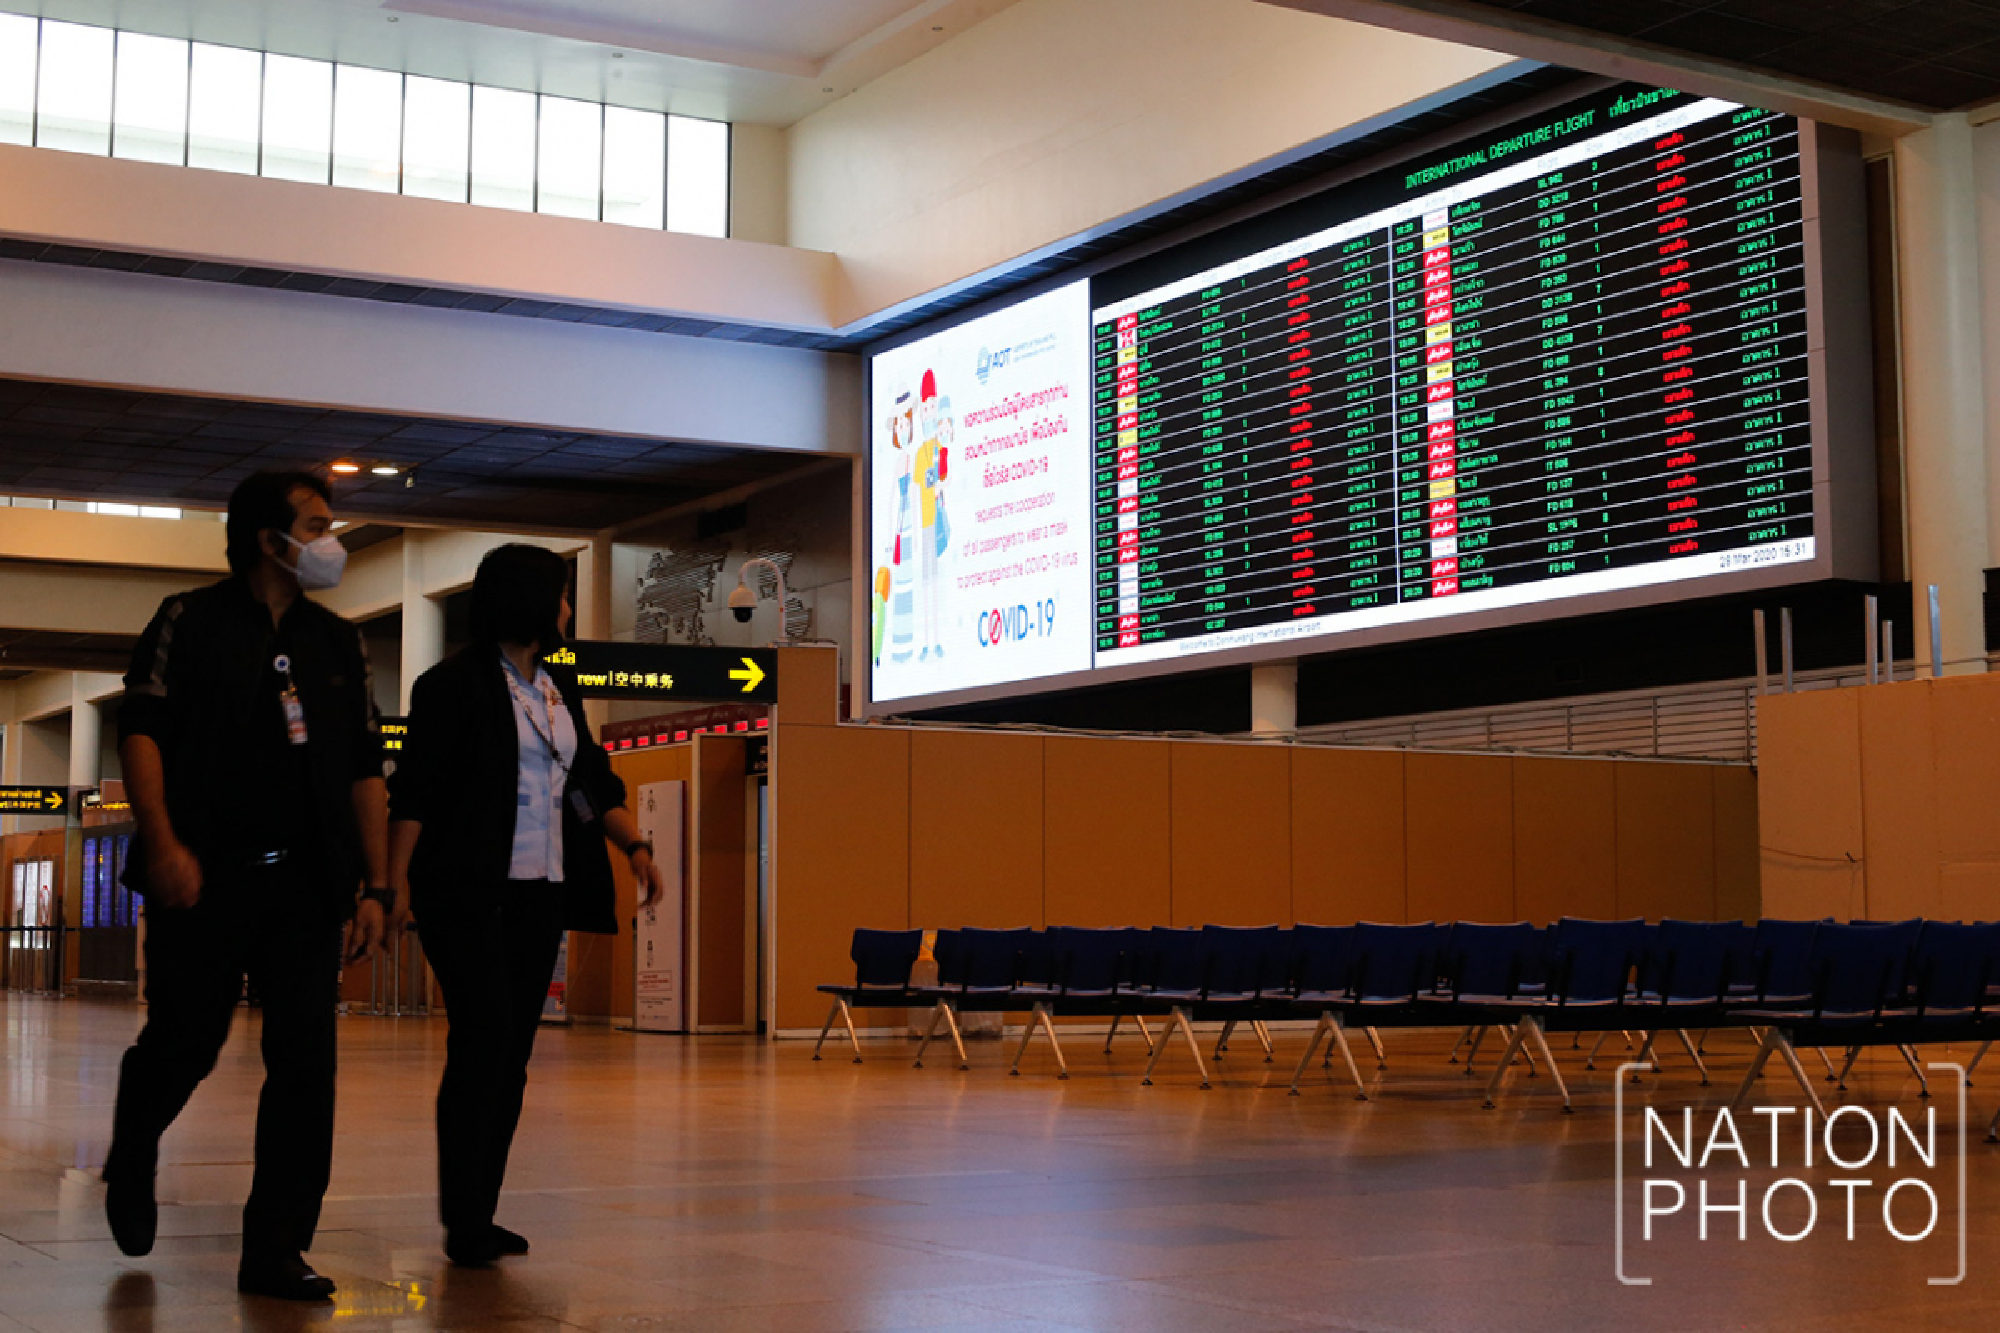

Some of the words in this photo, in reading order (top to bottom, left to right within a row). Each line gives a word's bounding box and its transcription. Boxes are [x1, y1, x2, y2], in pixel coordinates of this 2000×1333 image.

[1405, 150, 1487, 188] INTERNATIONAL
[1490, 125, 1552, 160] DEPARTURE
[1555, 110, 1595, 137] FLIGHT
[978, 598, 1055, 647] COVID-19
